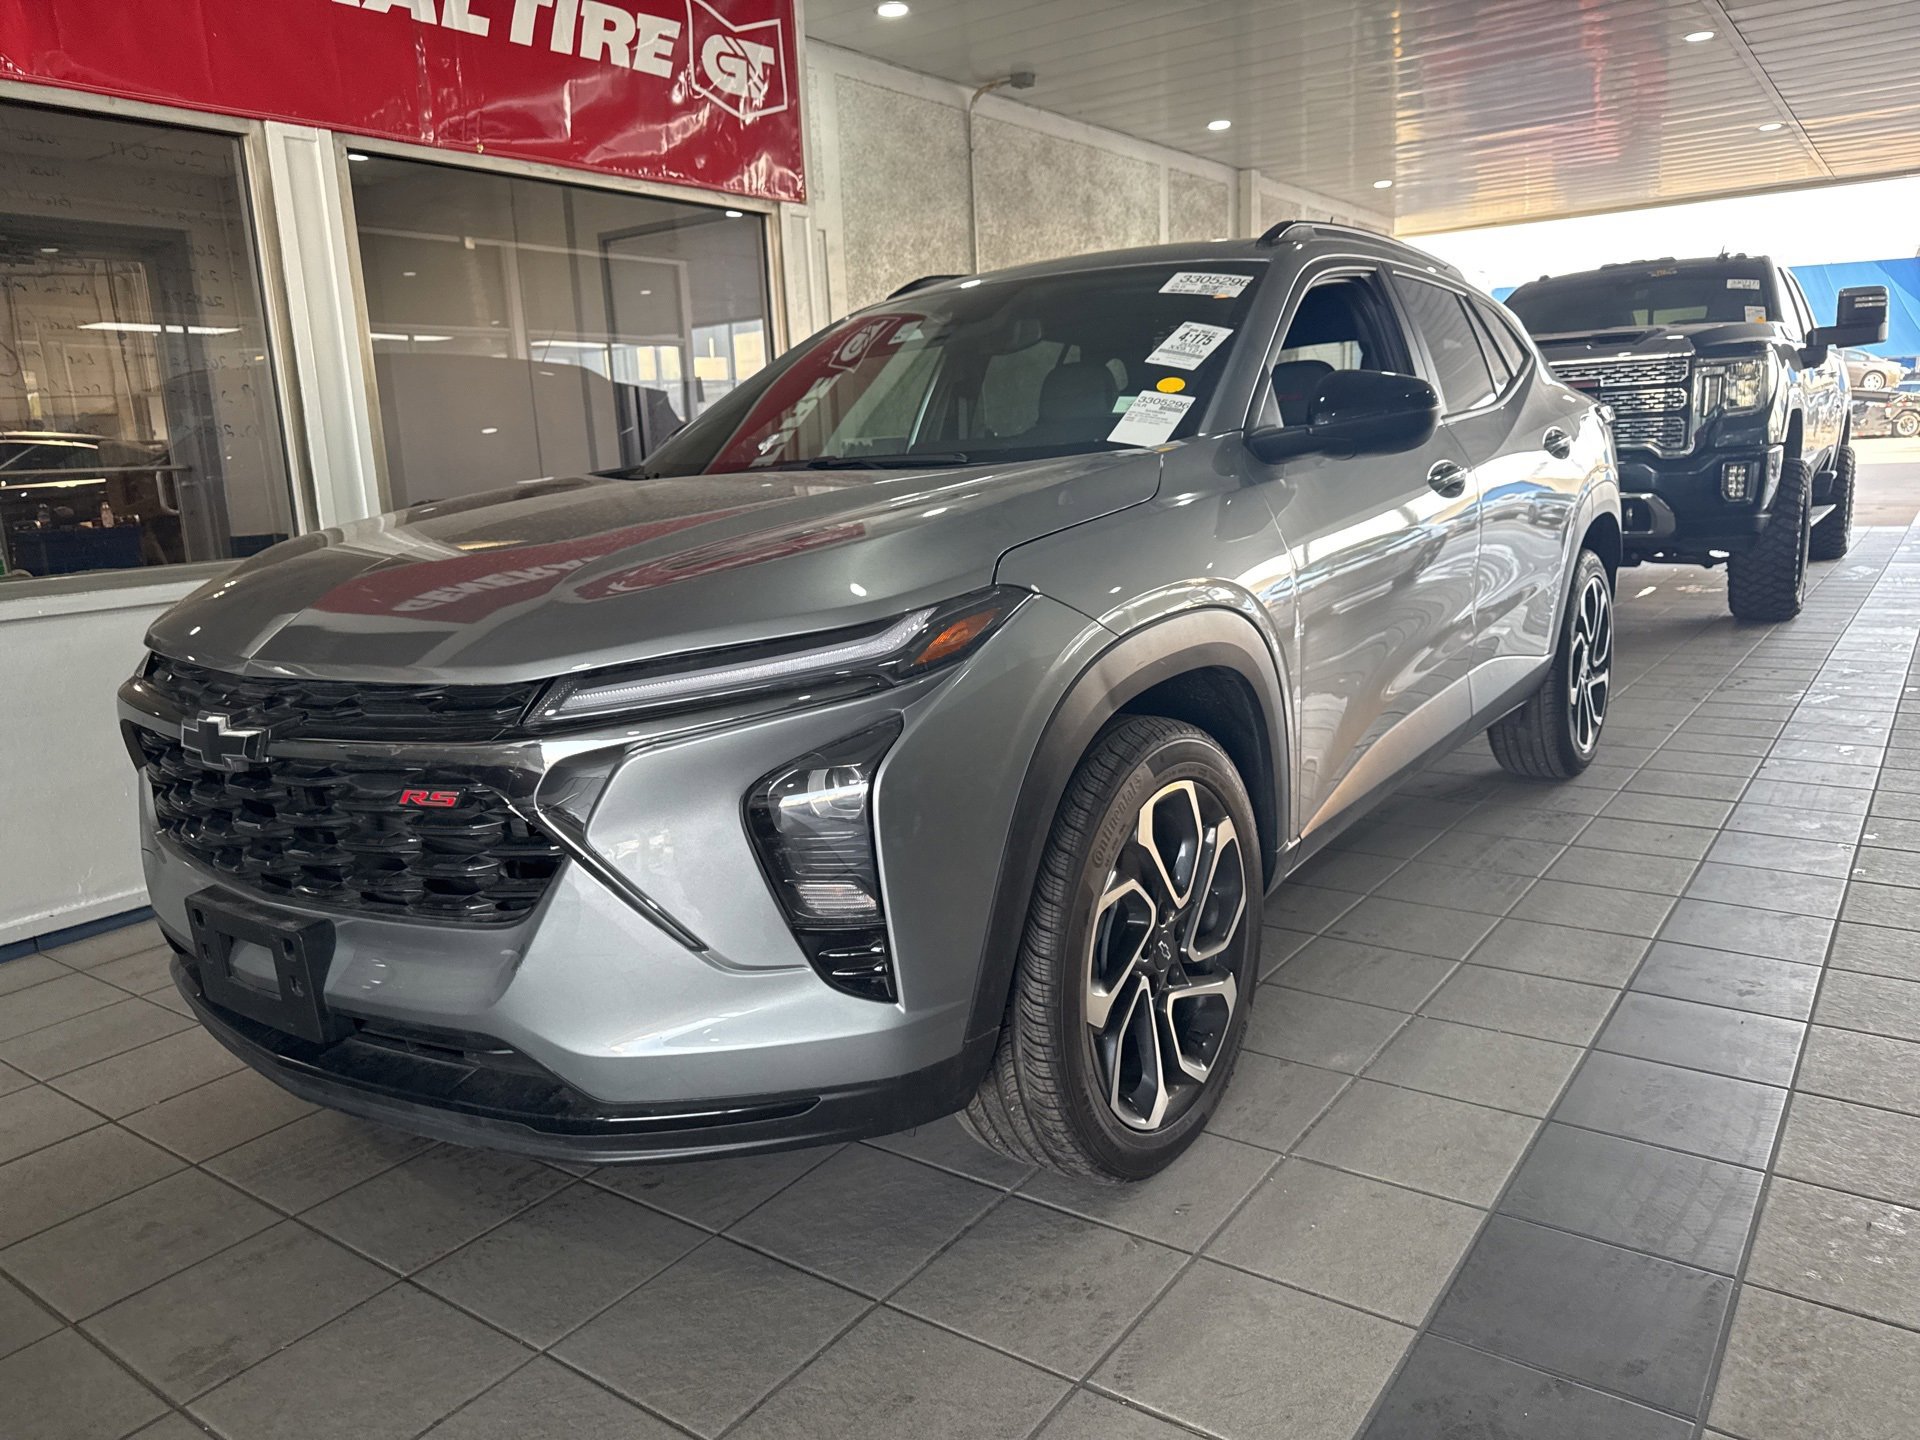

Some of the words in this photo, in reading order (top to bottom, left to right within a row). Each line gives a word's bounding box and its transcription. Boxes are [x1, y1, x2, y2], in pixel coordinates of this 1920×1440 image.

[509, 0, 682, 79] TIRE
[702, 34, 775, 100] GT
[1138, 396, 1191, 409] 3305296
[400, 790, 459, 806] RS
[1093, 783, 1140, 868] Continental
